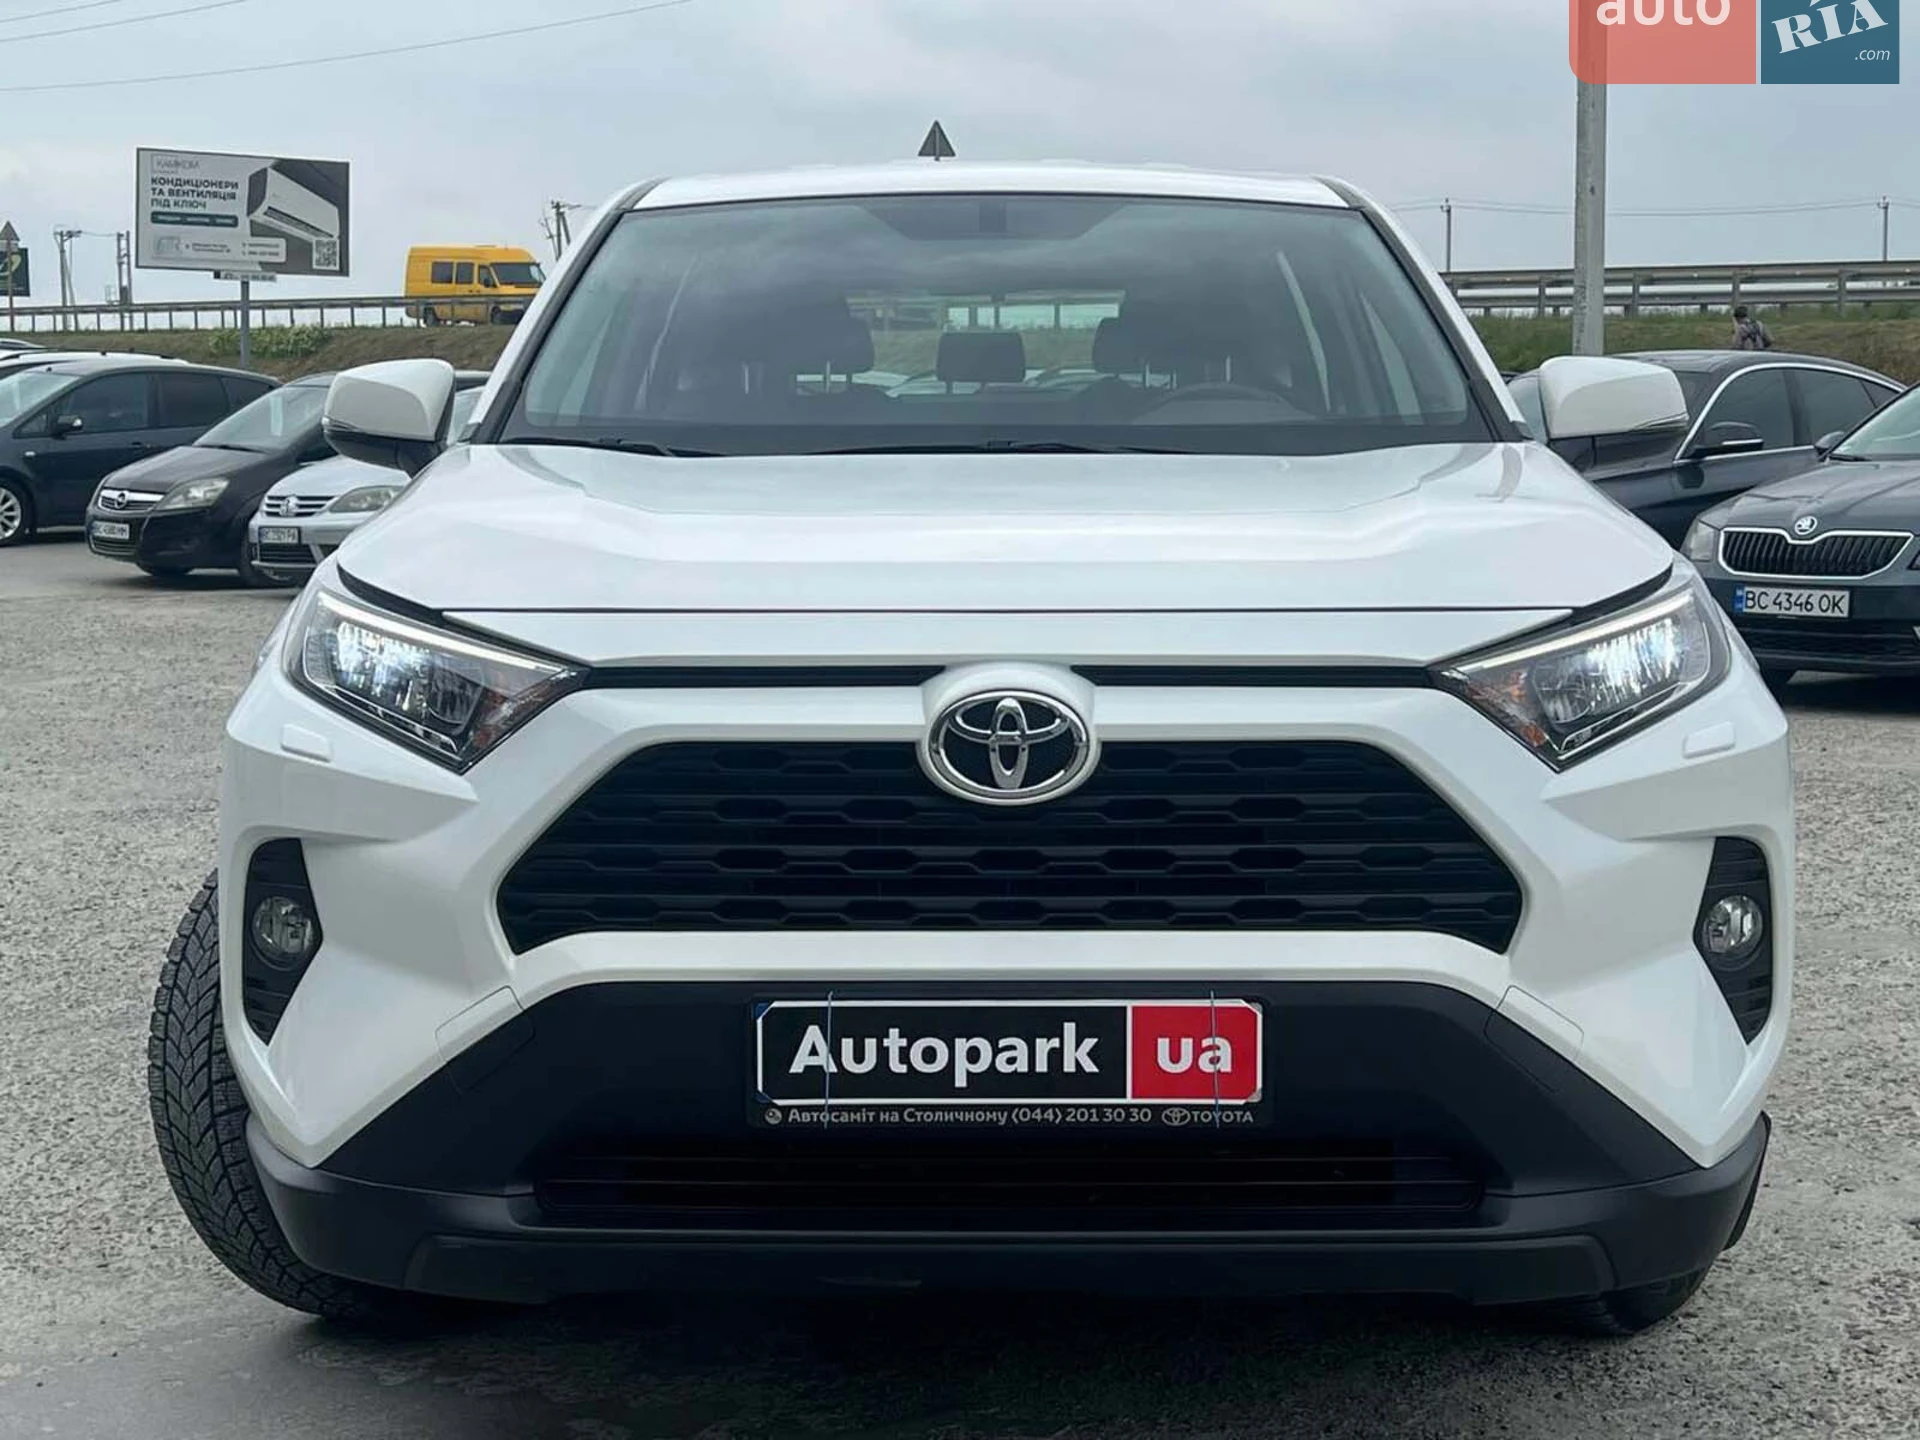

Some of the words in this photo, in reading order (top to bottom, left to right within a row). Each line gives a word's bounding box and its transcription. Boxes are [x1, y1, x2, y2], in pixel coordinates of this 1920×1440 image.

[151, 176, 239, 190] КОНДИЦІОНЕРИ
[151, 187, 165, 196] ТА
[169, 189, 236, 201] ВЕНТИЛЯЦІЯ
[151, 199, 171, 208] ПІД
[174, 199, 206, 210] КЛЮЧ
[1744, 590, 1769, 610] BC
[1772, 592, 1814, 613] 4346
[1818, 594, 1846, 614] OK
[788, 1022, 1099, 1087] Autopark
[1157, 1036, 1232, 1073] ua
[787, 1108, 875, 1123] Автосаміт
[879, 1112, 900, 1123] на
[903, 1108, 1007, 1126] Столичному
[1011, 1107, 1063, 1124] (044)
[1065, 1108, 1100, 1123] 201
[1102, 1108, 1126, 1123] 30
[1129, 1108, 1152, 1123] 30
[1190, 1111, 1254, 1123] TOYOTA
